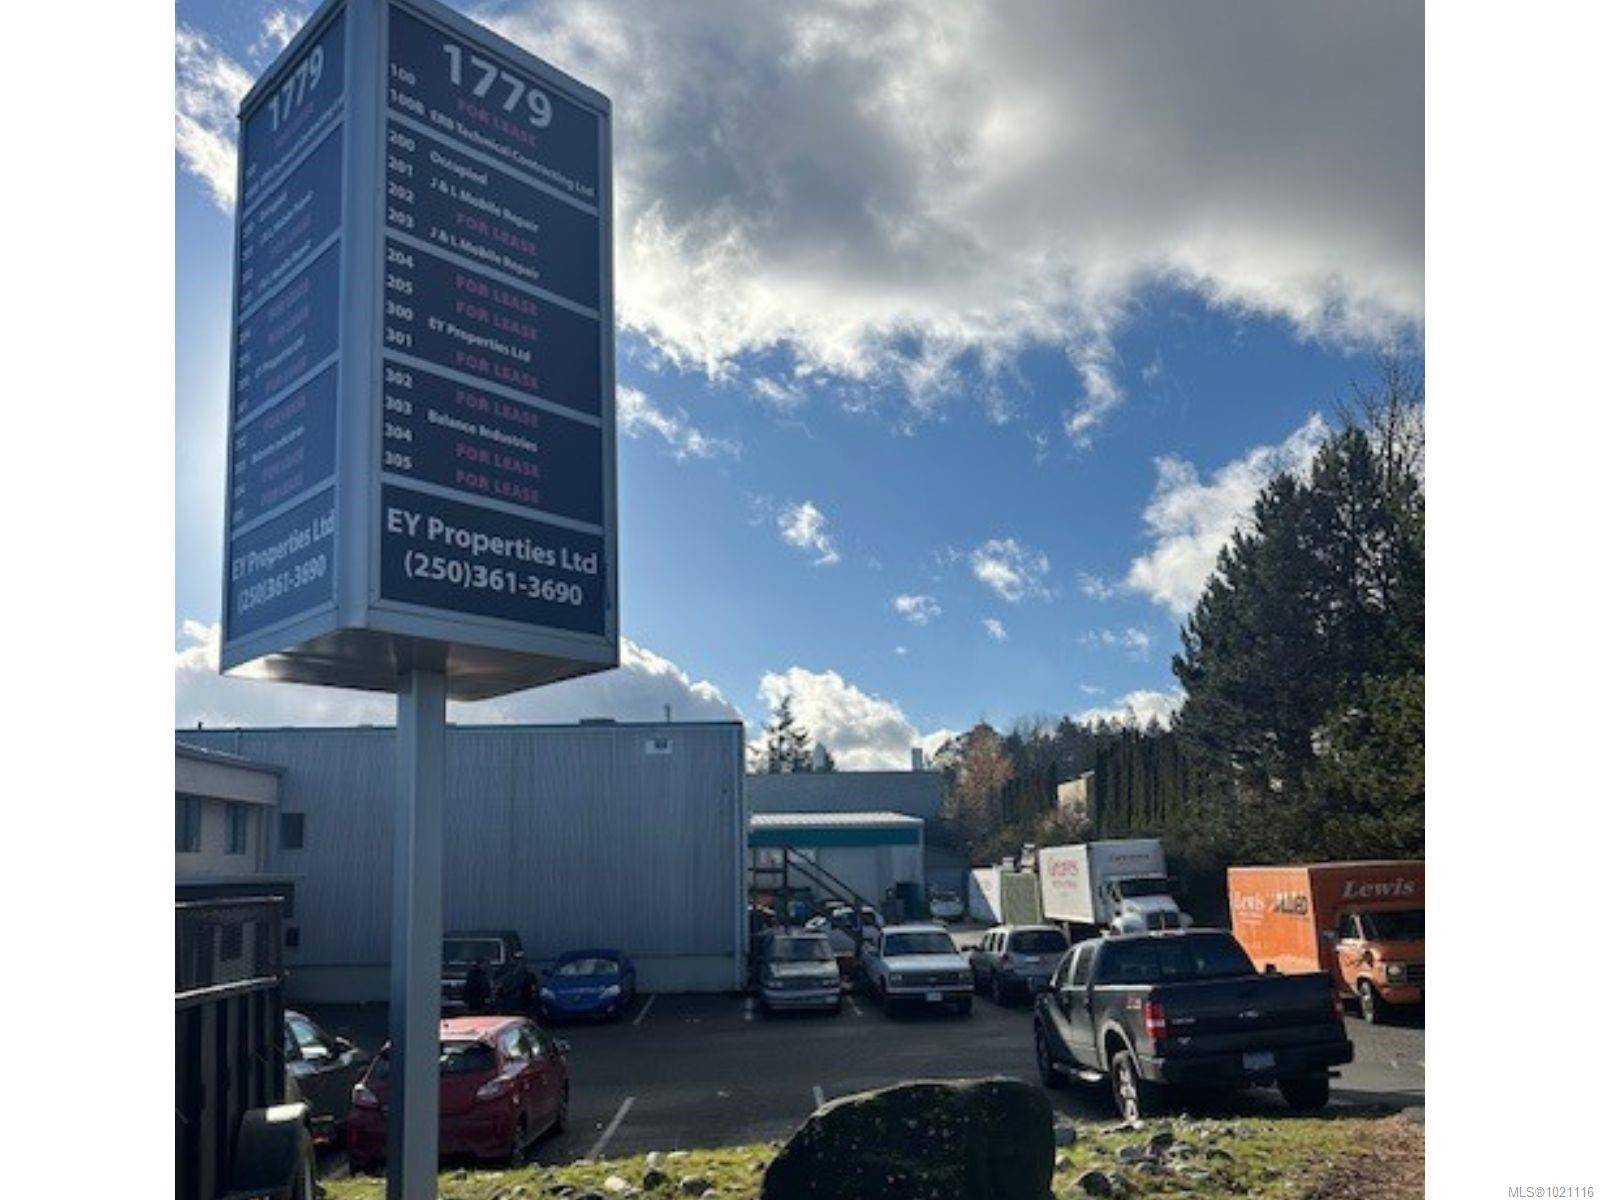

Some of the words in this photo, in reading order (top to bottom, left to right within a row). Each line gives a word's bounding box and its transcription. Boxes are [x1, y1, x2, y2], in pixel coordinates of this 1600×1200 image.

[268, 45, 324, 131] 1779
[390, 63, 415, 86] 100
[443, 44, 553, 128] 1779
[389, 131, 415, 152] 200
[430, 151, 488, 185] Occupied
[457, 122, 511, 159] Technical
[512, 150, 573, 192] Contracting
[574, 183, 595, 197] Ltd
[388, 181, 415, 204] 202
[457, 212, 490, 236] FOR
[493, 229, 537, 256] LEASE
[389, 156, 413, 178] 201
[460, 189, 501, 217] Mobile
[502, 207, 539, 231] Repair
[388, 207, 415, 229] 203
[460, 238, 501, 264] Mobile
[502, 255, 540, 280] Repair
[387, 247, 414, 269] 204
[456, 275, 490, 297] FOR
[493, 289, 538, 316] LEASE
[387, 273, 413, 295] 205
[456, 301, 490, 323] FOR
[493, 314, 538, 340] LEASE
[386, 300, 414, 321] 300
[428, 316, 446, 333] EY
[447, 322, 511, 357] Properties
[512, 345, 531, 362] Ltd
[386, 327, 413, 348] 301
[456, 352, 490, 374] FOR
[494, 364, 539, 389] LEASE
[385, 367, 413, 389] 302
[456, 390, 489, 412] FOR
[494, 402, 539, 428] LEASE
[385, 396, 413, 416] 303
[427, 409, 477, 435] Balance
[479, 424, 538, 453] Industries
[385, 422, 413, 442] 304
[455, 442, 489, 465] FOR
[494, 453, 539, 478] LEASE
[385, 450, 412, 470] 305
[455, 469, 489, 492] FOR
[494, 480, 539, 504] LEASE
[247, 527, 312, 574] Properties
[387, 507, 420, 536] EY
[427, 517, 556, 567] Properties
[562, 547, 598, 574] Ltd
[403, 550, 582, 606] (250)361-3690
[1341, 880, 1416, 899] Lewis
